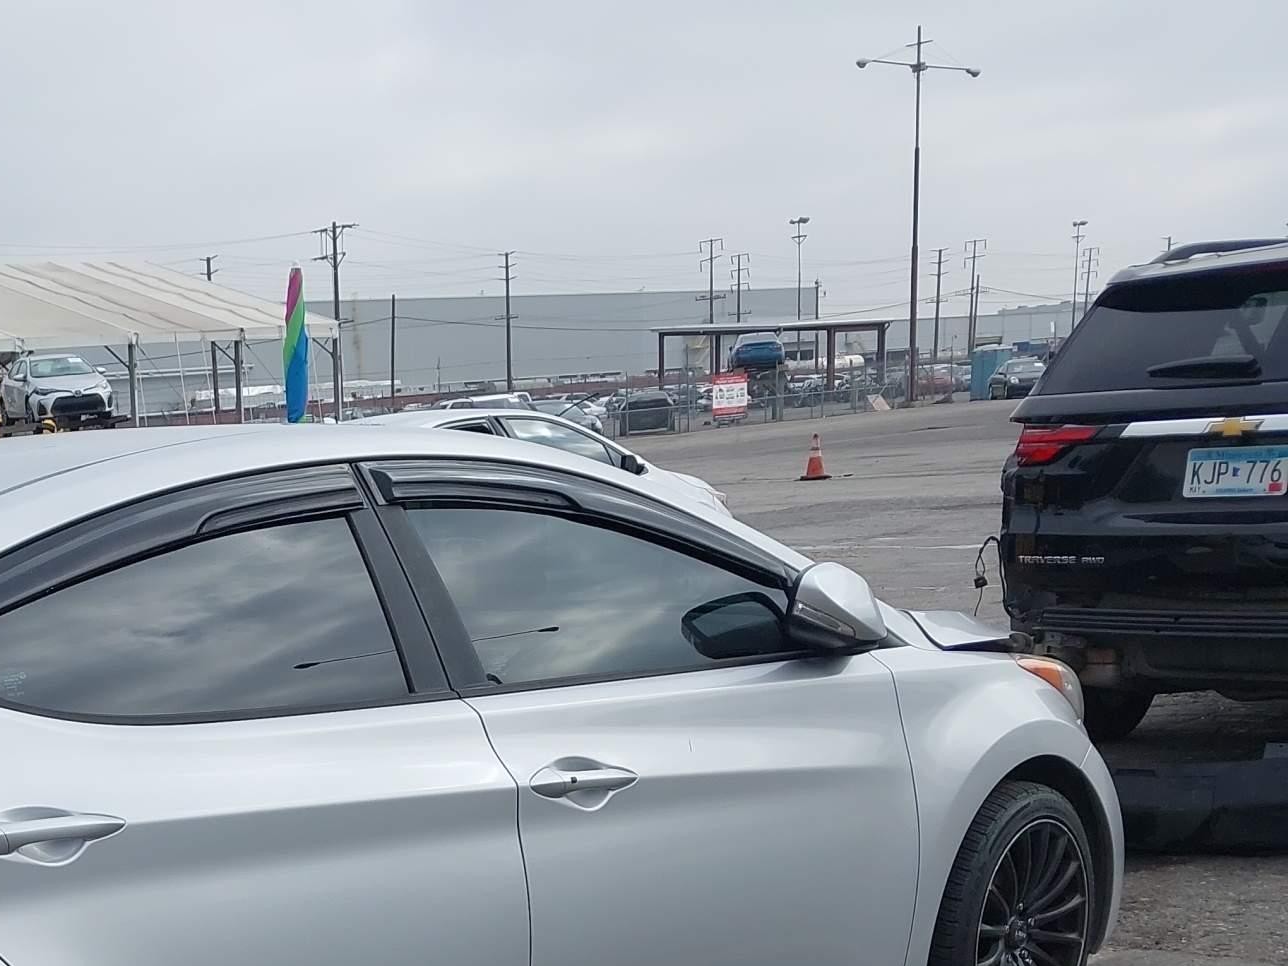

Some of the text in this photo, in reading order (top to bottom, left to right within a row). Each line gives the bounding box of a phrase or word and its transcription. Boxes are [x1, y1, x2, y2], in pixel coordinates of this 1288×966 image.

[1190, 460, 1282, 485] KJP 776
[1018, 555, 1105, 564] TRAVERSE AWD
